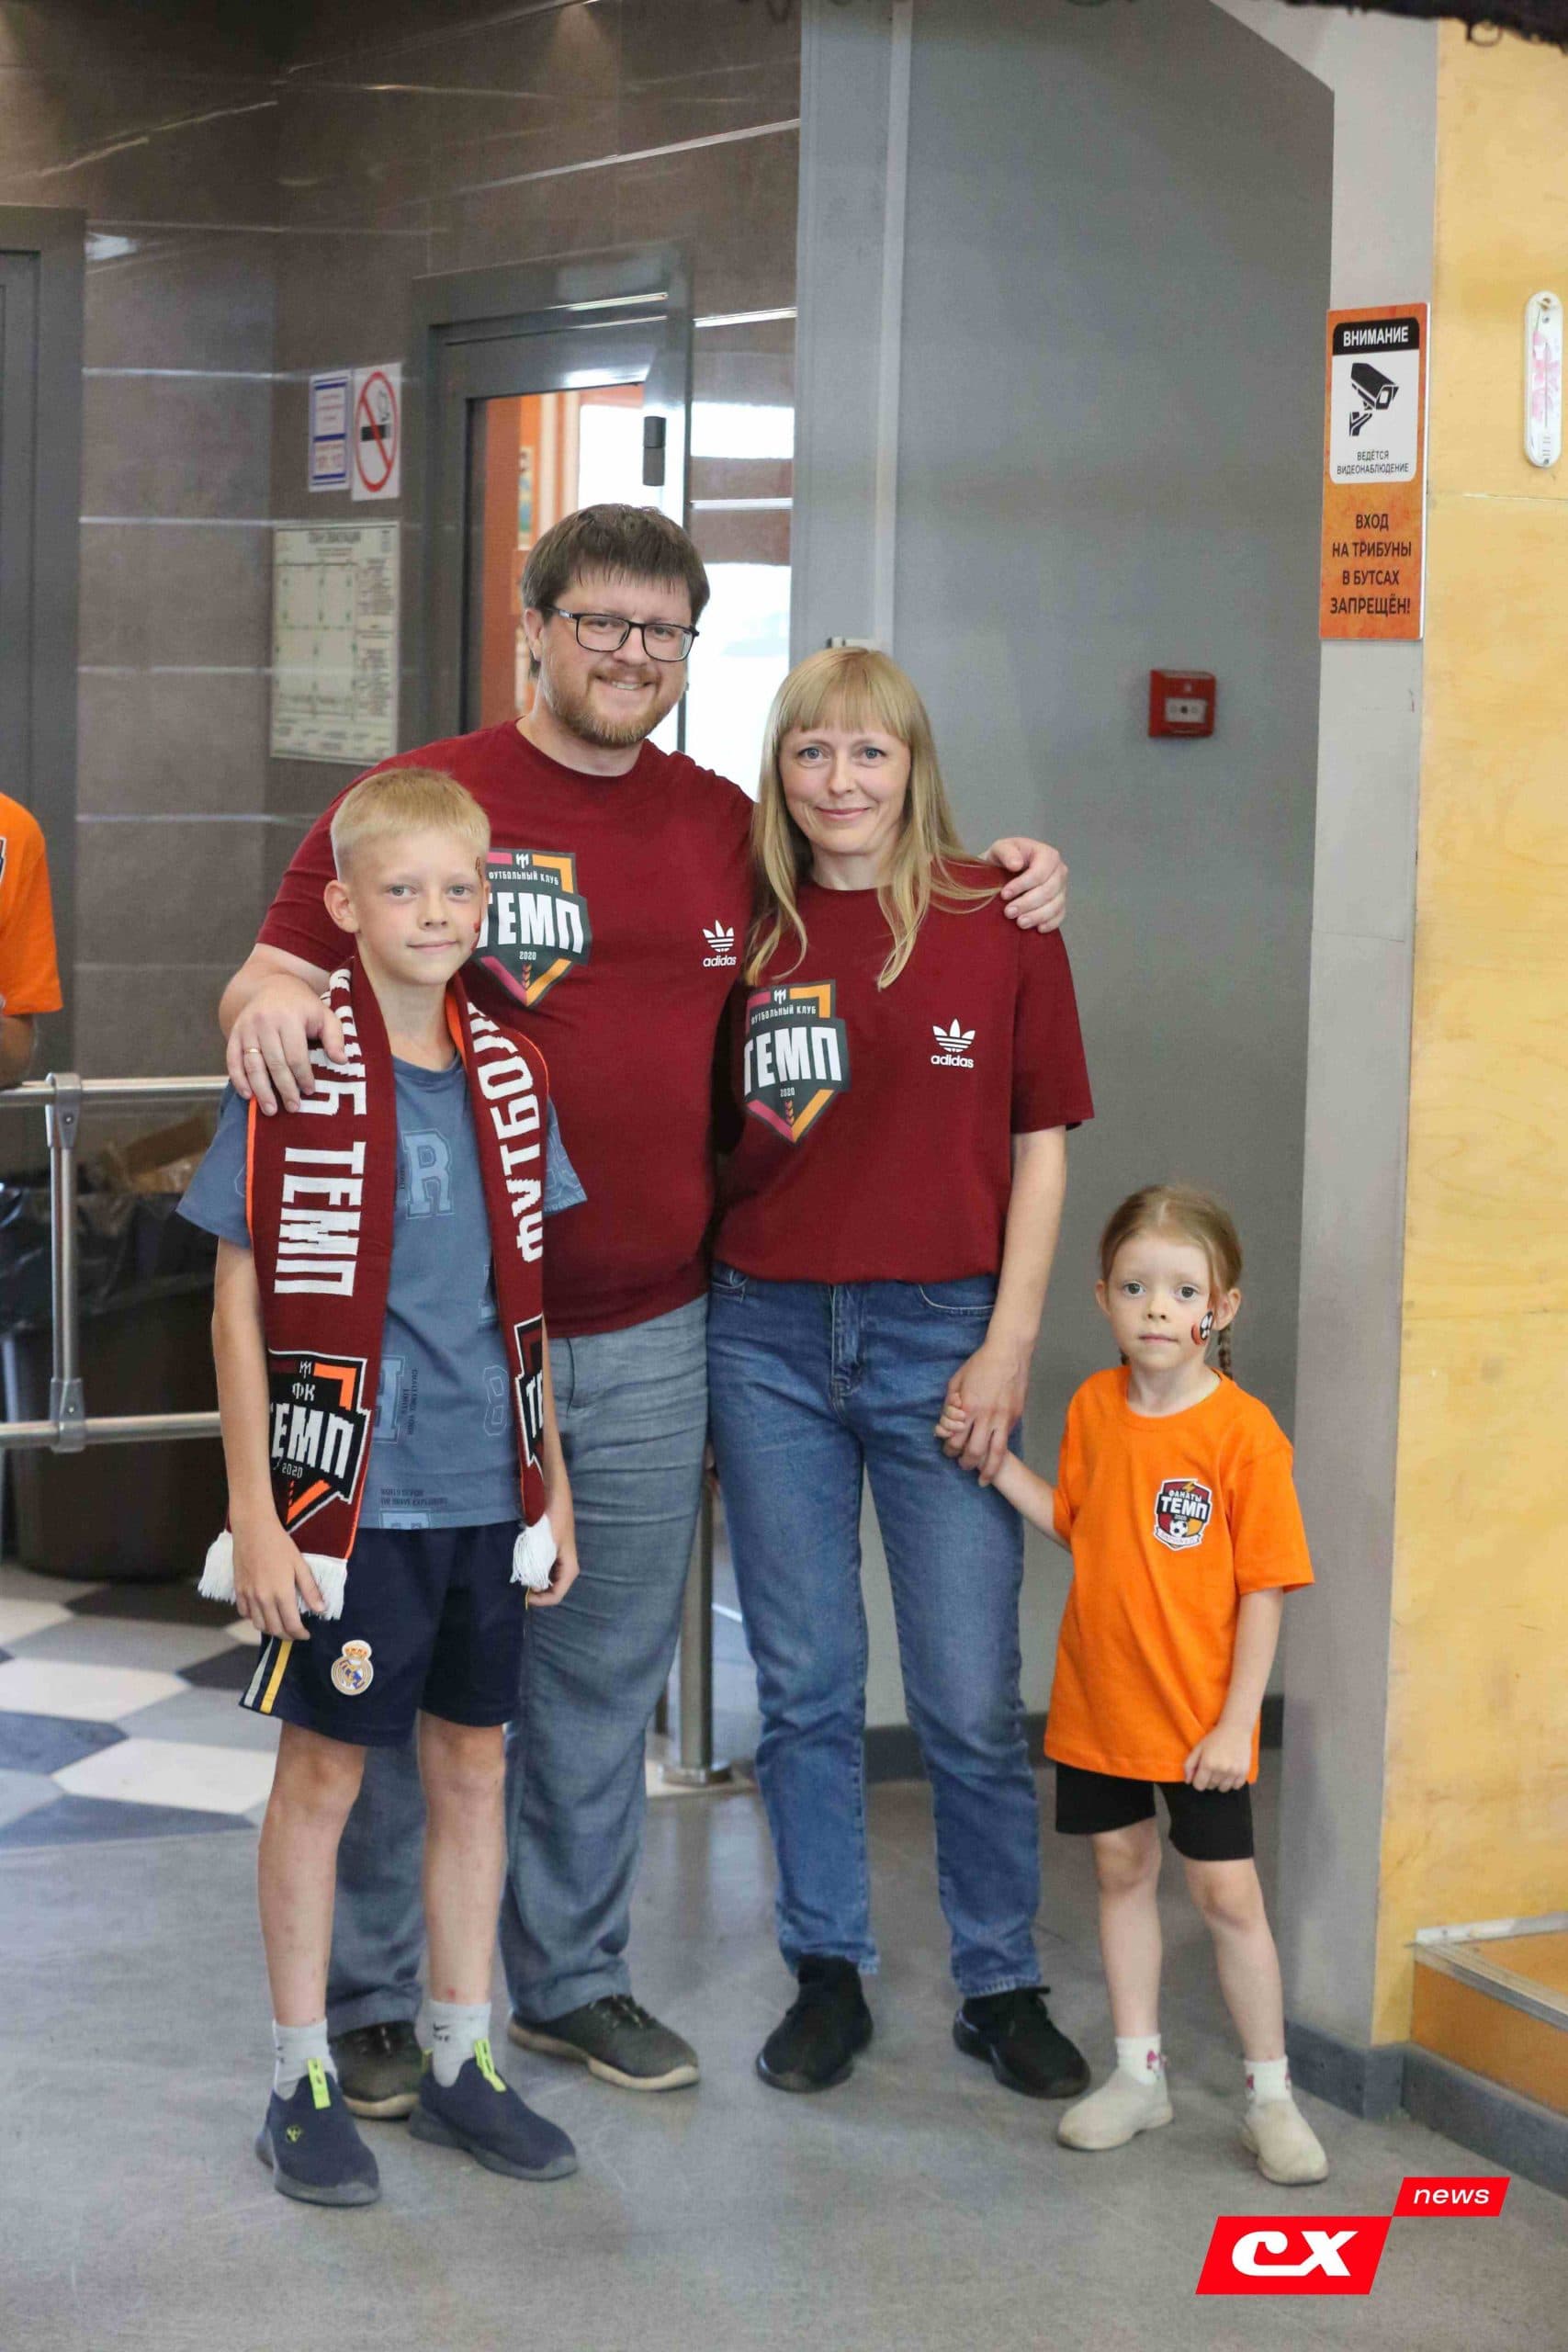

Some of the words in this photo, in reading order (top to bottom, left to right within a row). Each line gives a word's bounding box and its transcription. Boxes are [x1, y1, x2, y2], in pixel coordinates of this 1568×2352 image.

[1343, 326, 1409, 347] ВНИМАНИЕ
[1357, 449, 1389, 461] ВЕДЁТСЯ
[1337, 462, 1409, 475] ВИДЕОНАБЛЮДЕНИЕ
[1355, 514, 1389, 531] ВХОД
[1332, 542, 1349, 558] НА
[1352, 540, 1412, 558] ТРИБУНЫ
[1342, 570, 1350, 585] В
[1354, 570, 1400, 585] БУТСАХ
[1329, 593, 1411, 616] ЗАПРЕЩЁН!
[489, 871, 538, 880] ФУТБОЛЬНЫЙ
[540, 873, 559, 886] КЛУБ
[519, 951, 536, 960] 2020
[703, 955, 737, 967] adidas
[796, 1006, 817, 1015] КЛУБ
[931, 1053, 975, 1069] adidas
[780, 1087, 795, 1098] 2020
[274, 1141, 367, 1297] ТЕМП
[292, 1382, 315, 1401] ФК
[271, 1402, 354, 1479] ЕМП
[281, 1463, 303, 1478] 2020
[1168, 1489, 1201, 1502] ФАНАТЫ
[1160, 1496, 1208, 1521] ТЕМП
